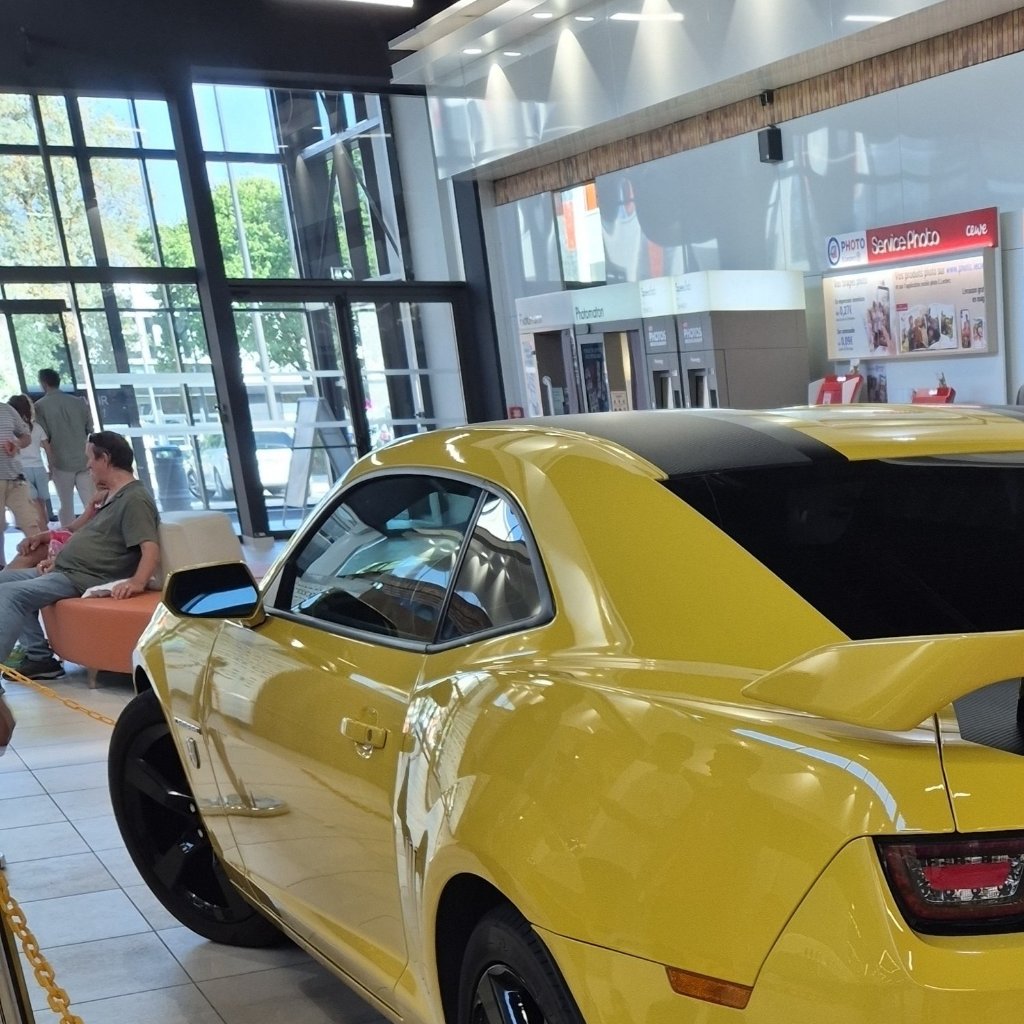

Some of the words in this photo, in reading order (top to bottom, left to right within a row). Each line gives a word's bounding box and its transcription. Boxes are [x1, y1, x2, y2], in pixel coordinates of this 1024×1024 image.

[841, 237, 865, 251] PHOTO
[871, 234, 906, 255] Service
[906, 227, 940, 250] Photo
[575, 306, 604, 320] Photomaton
